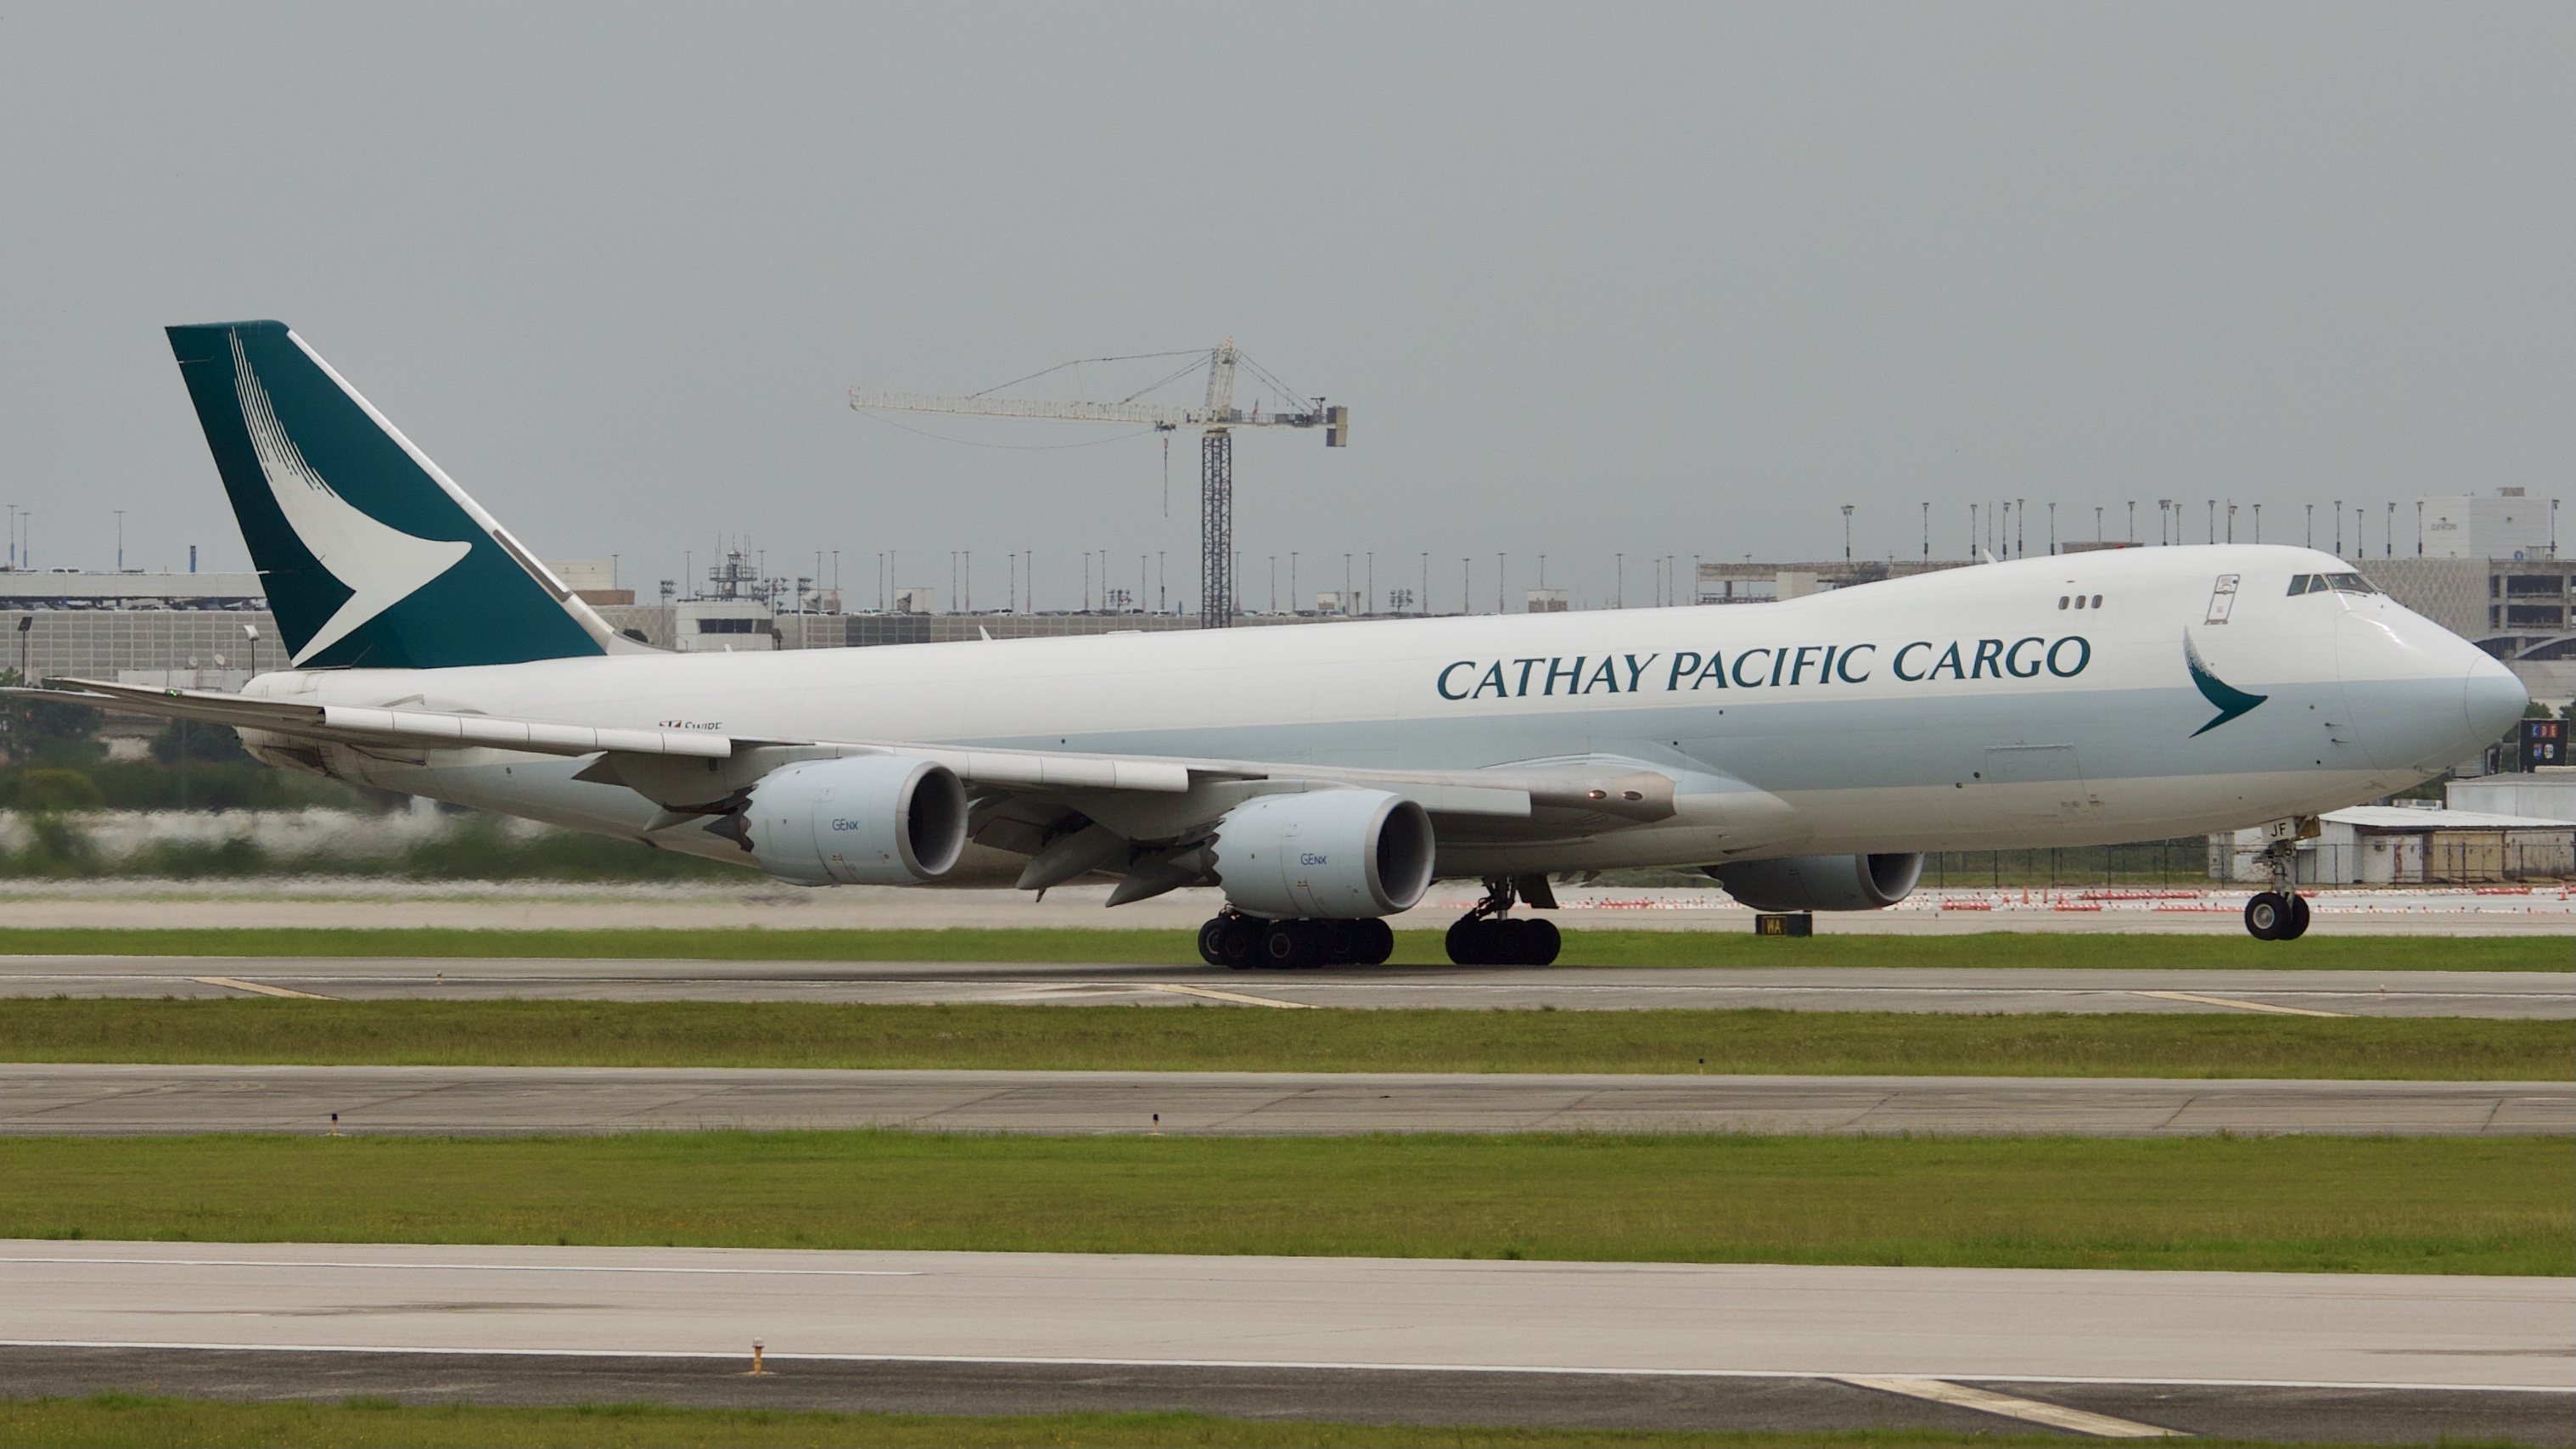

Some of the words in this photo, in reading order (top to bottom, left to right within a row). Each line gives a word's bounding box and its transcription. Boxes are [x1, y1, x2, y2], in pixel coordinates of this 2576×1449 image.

[1437, 653, 1661, 701] CATHAY
[1666, 643, 1877, 691] PACIFIC
[1893, 635, 2091, 682] CARGO
[2270, 822, 2287, 838] JF
[1766, 918, 1782, 935] WA
